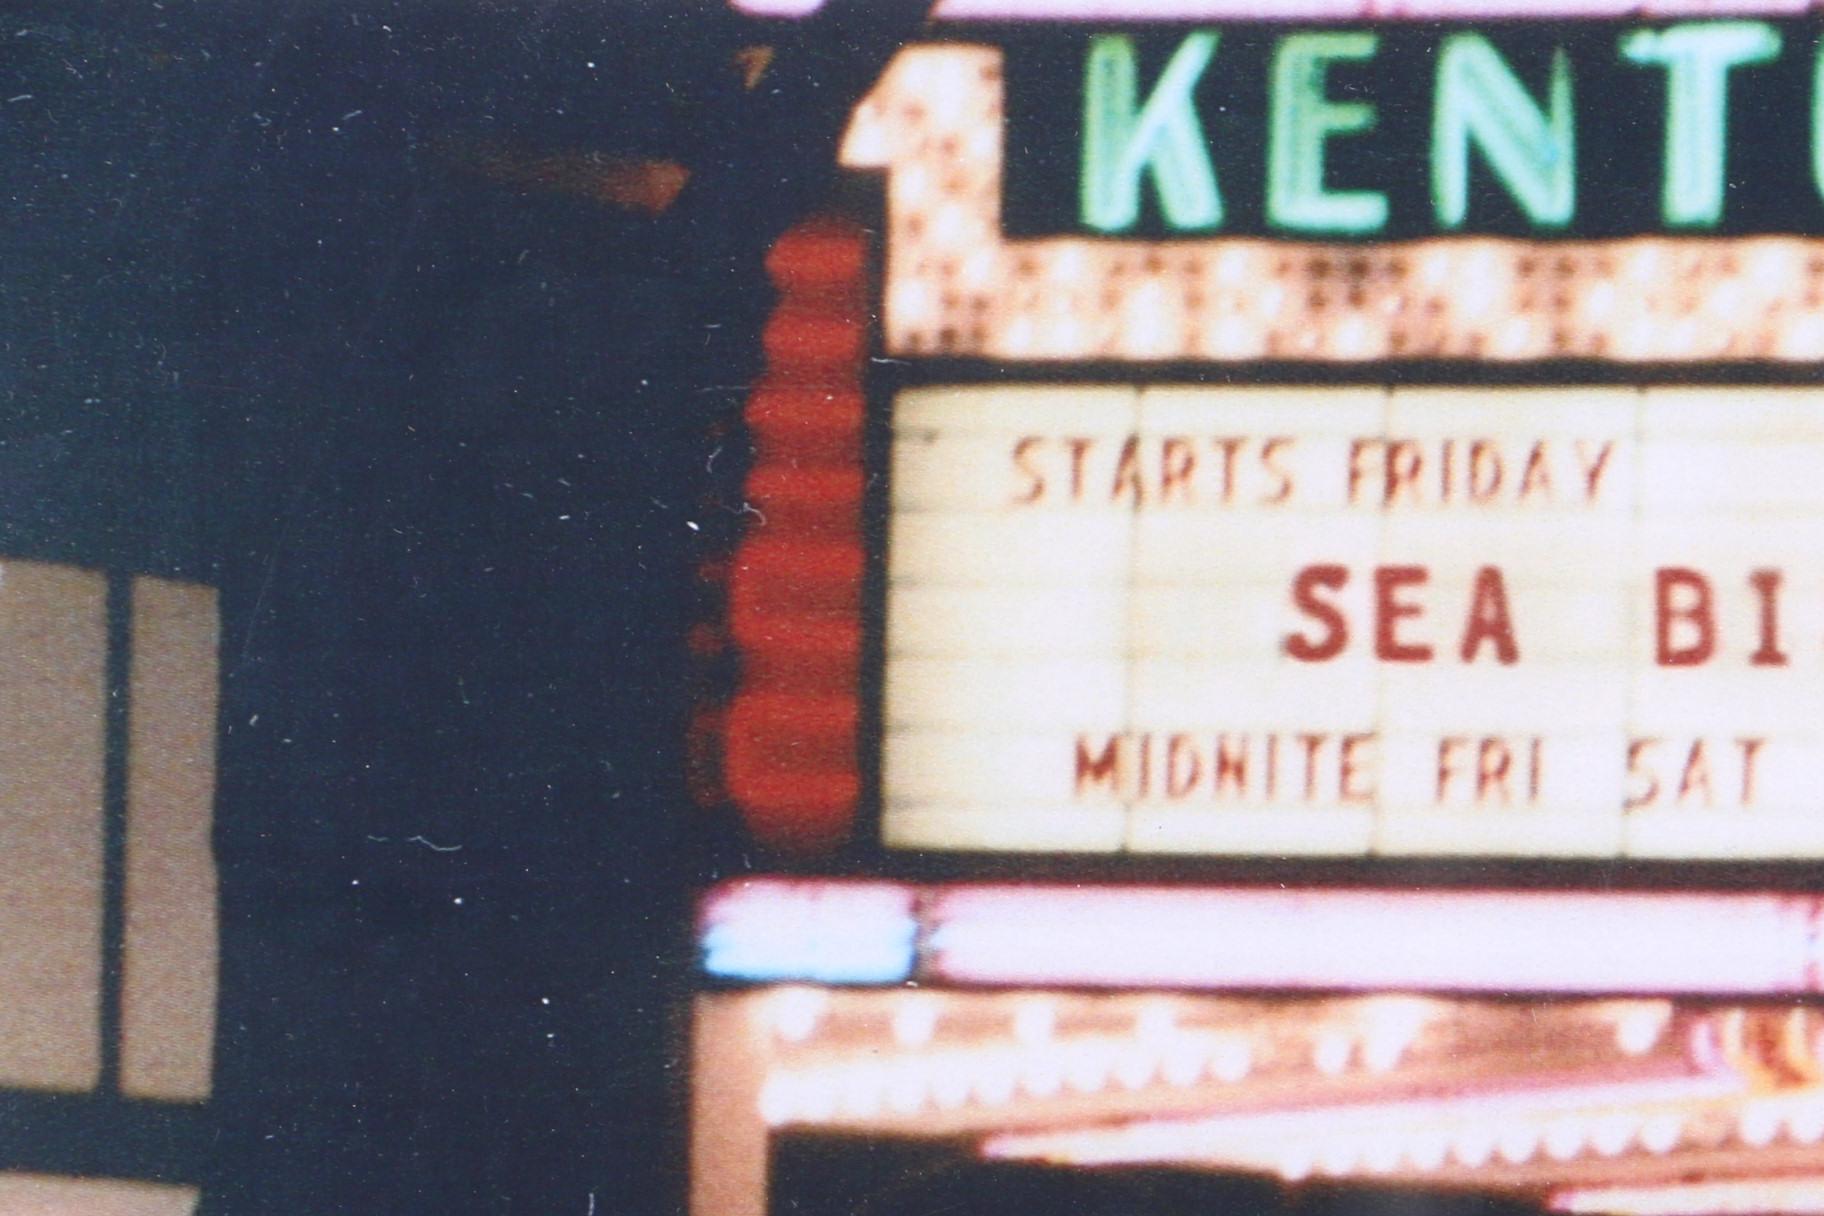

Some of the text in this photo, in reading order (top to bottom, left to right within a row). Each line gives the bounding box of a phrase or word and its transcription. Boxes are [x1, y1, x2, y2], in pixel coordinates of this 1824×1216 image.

[1012, 434, 1612, 508] STARTS FRIDAY
[1279, 563, 1519, 666] SEA
[1073, 732, 1765, 808] MIDNITE FRI SAT
